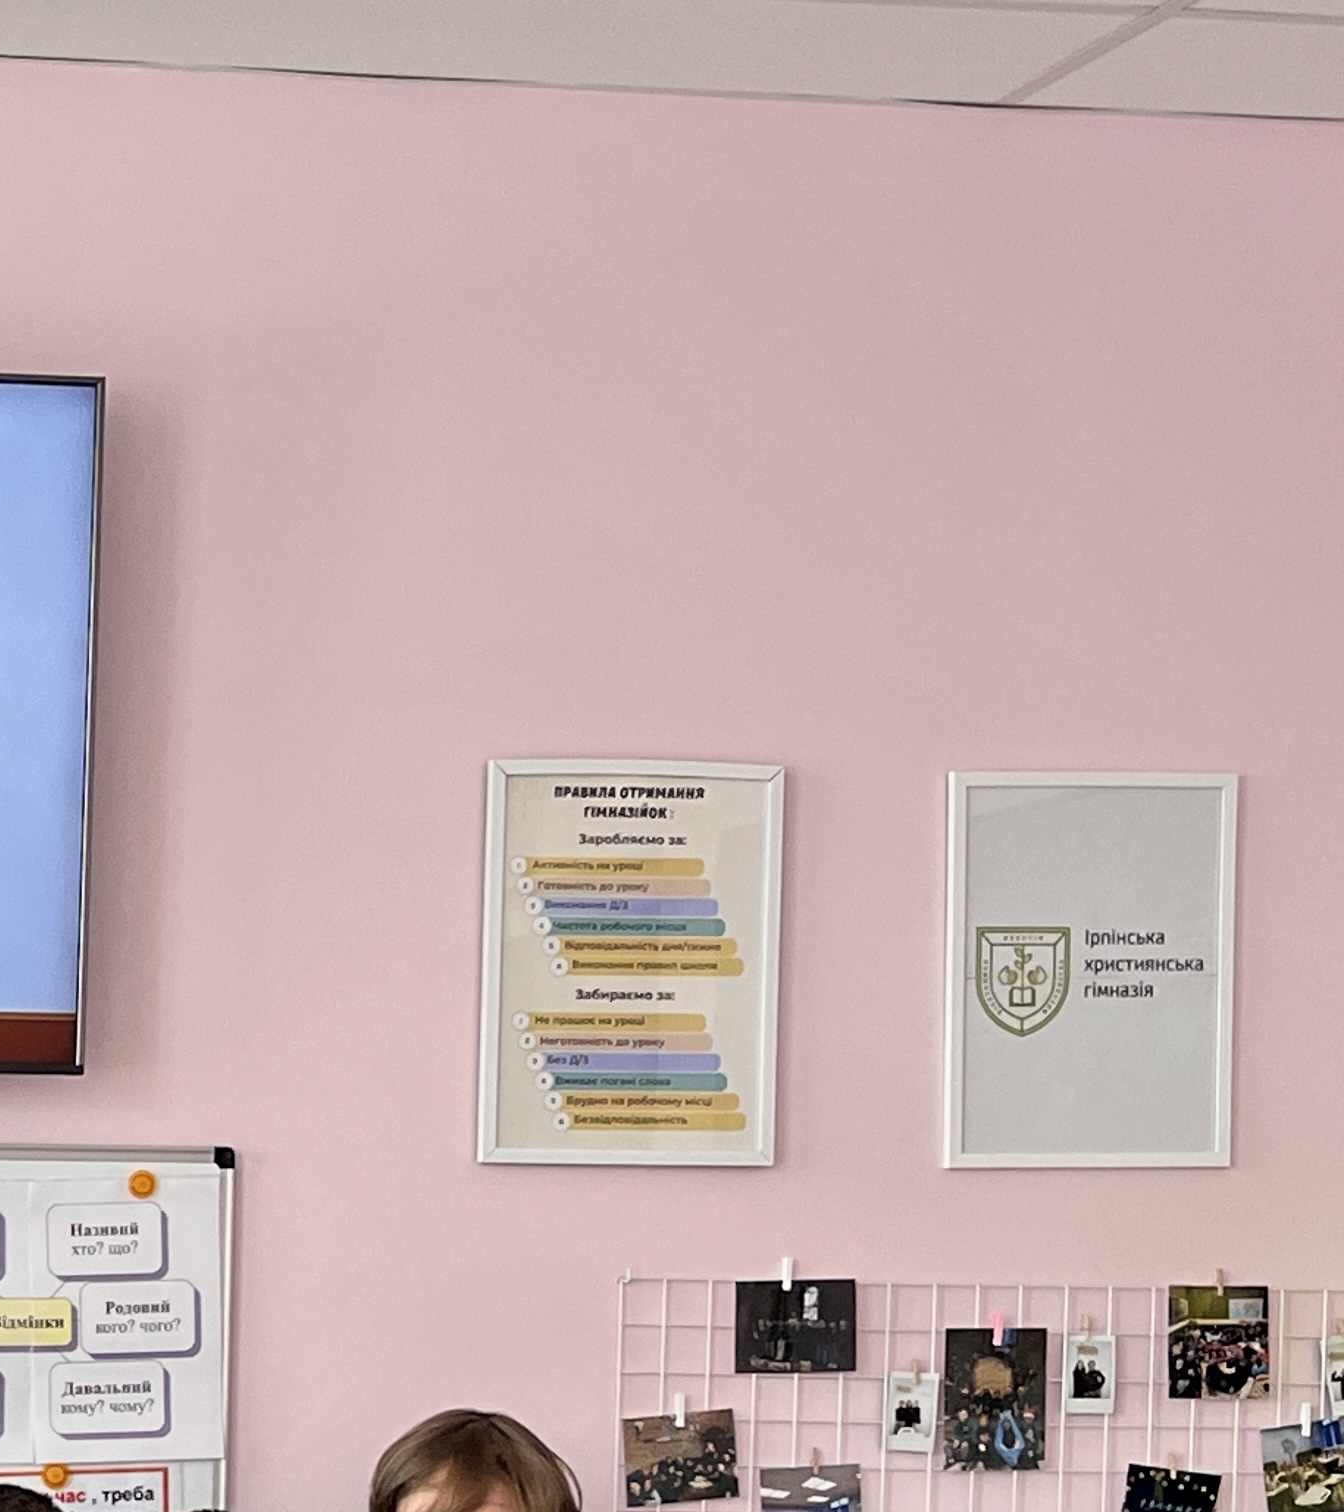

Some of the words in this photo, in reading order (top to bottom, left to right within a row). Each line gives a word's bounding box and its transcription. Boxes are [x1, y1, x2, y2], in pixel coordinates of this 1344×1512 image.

[554, 786, 616, 798] ПРАВИЛА
[620, 786, 705, 799] ОТРИМАННЯ
[579, 833, 664, 845] Заробляємо
[668, 836, 687, 845] за:
[1084, 928, 1165, 948] Ірпінська
[1084, 958, 1204, 975] християнська
[575, 988, 653, 1001] Забираємо
[656, 990, 676, 1001] за:
[1084, 980, 1154, 998] гімназія
[71, 1241, 104, 1256] хто?
[108, 1240, 138, 1256] що?
[105, 1300, 171, 1316] Родовий
[96, 1319, 135, 1334] кого?
[139, 1318, 181, 1333] чого?
[61, 1381, 152, 1397] Давальний
[60, 1400, 105, 1416] кому?
[109, 1399, 155, 1416] чому?
[54, 1490, 87, 1503] час
[101, 1487, 155, 1505] треба
